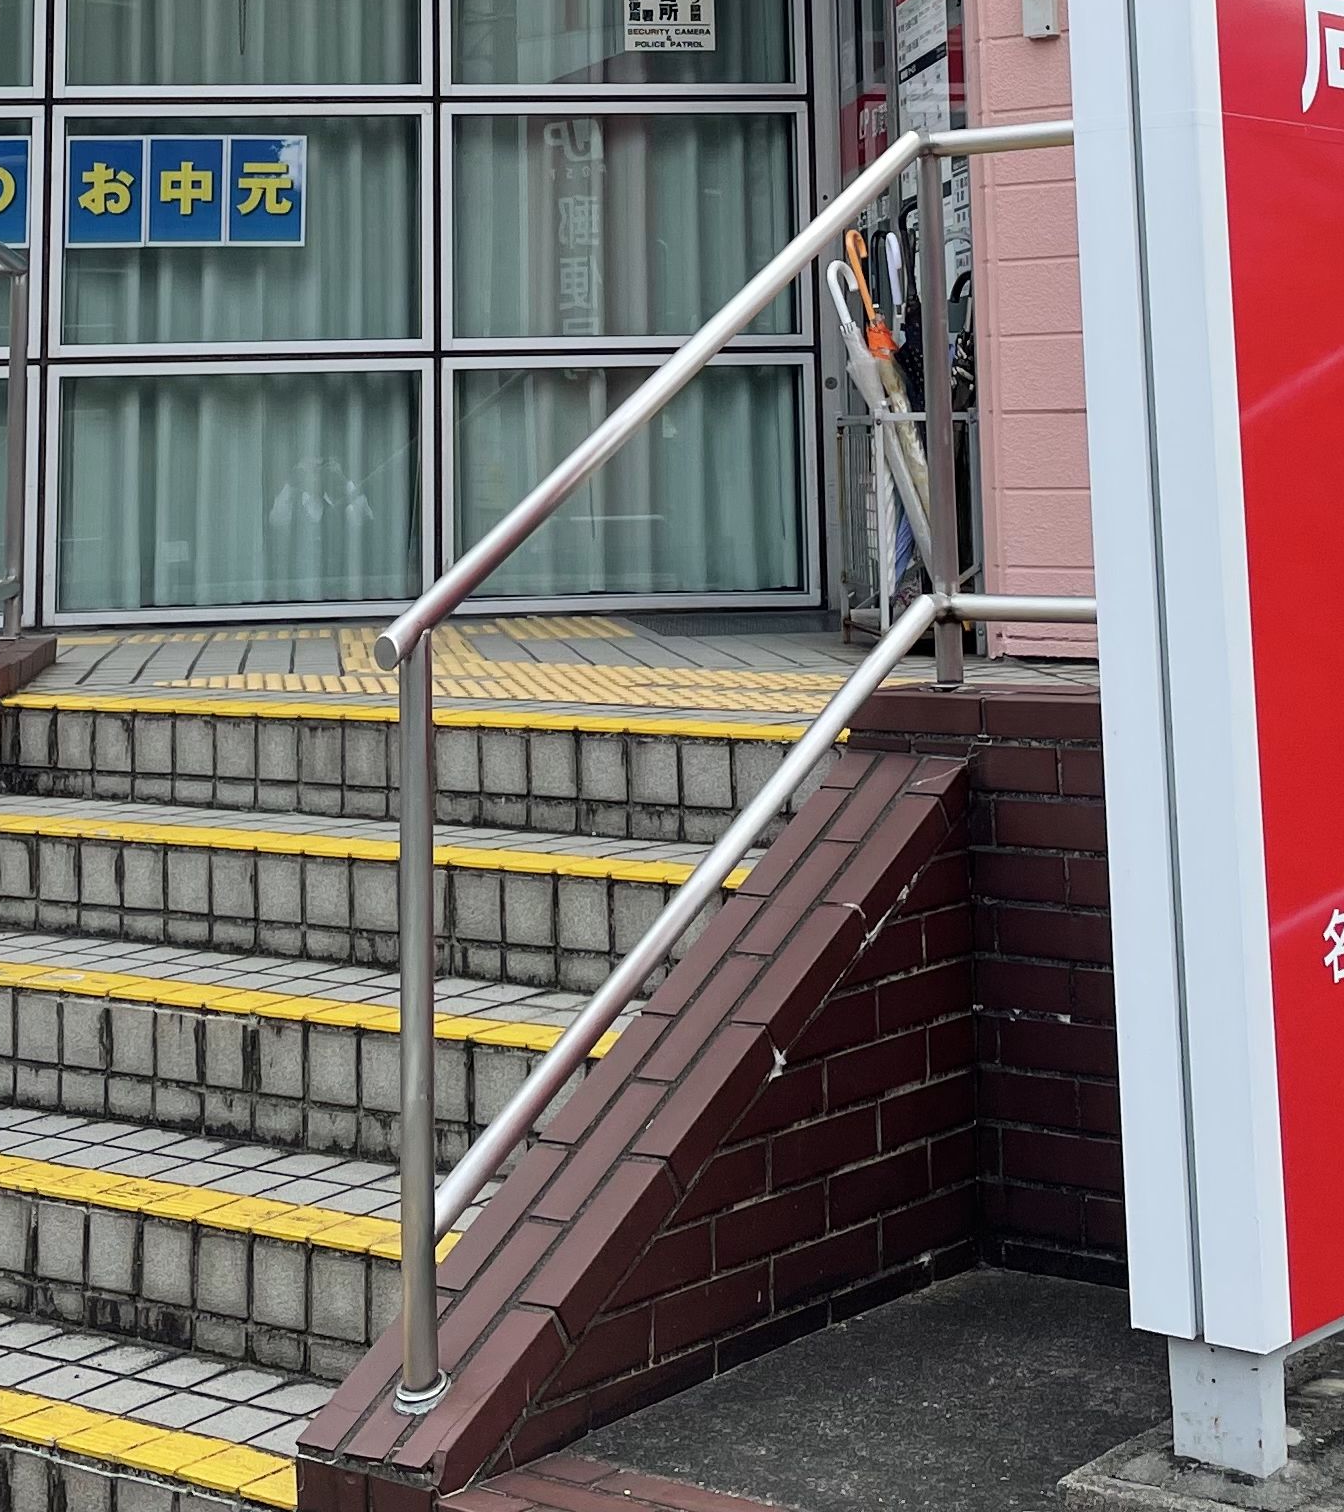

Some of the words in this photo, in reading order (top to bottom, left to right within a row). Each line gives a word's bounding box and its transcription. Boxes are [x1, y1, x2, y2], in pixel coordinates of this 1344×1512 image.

[627, 28, 670, 36] SECURITY
[674, 28, 711, 36] CAMERA
[634, 40, 665, 48] POLICE
[670, 40, 704, 48] PATROL
[77, 162, 294, 217] お中元
